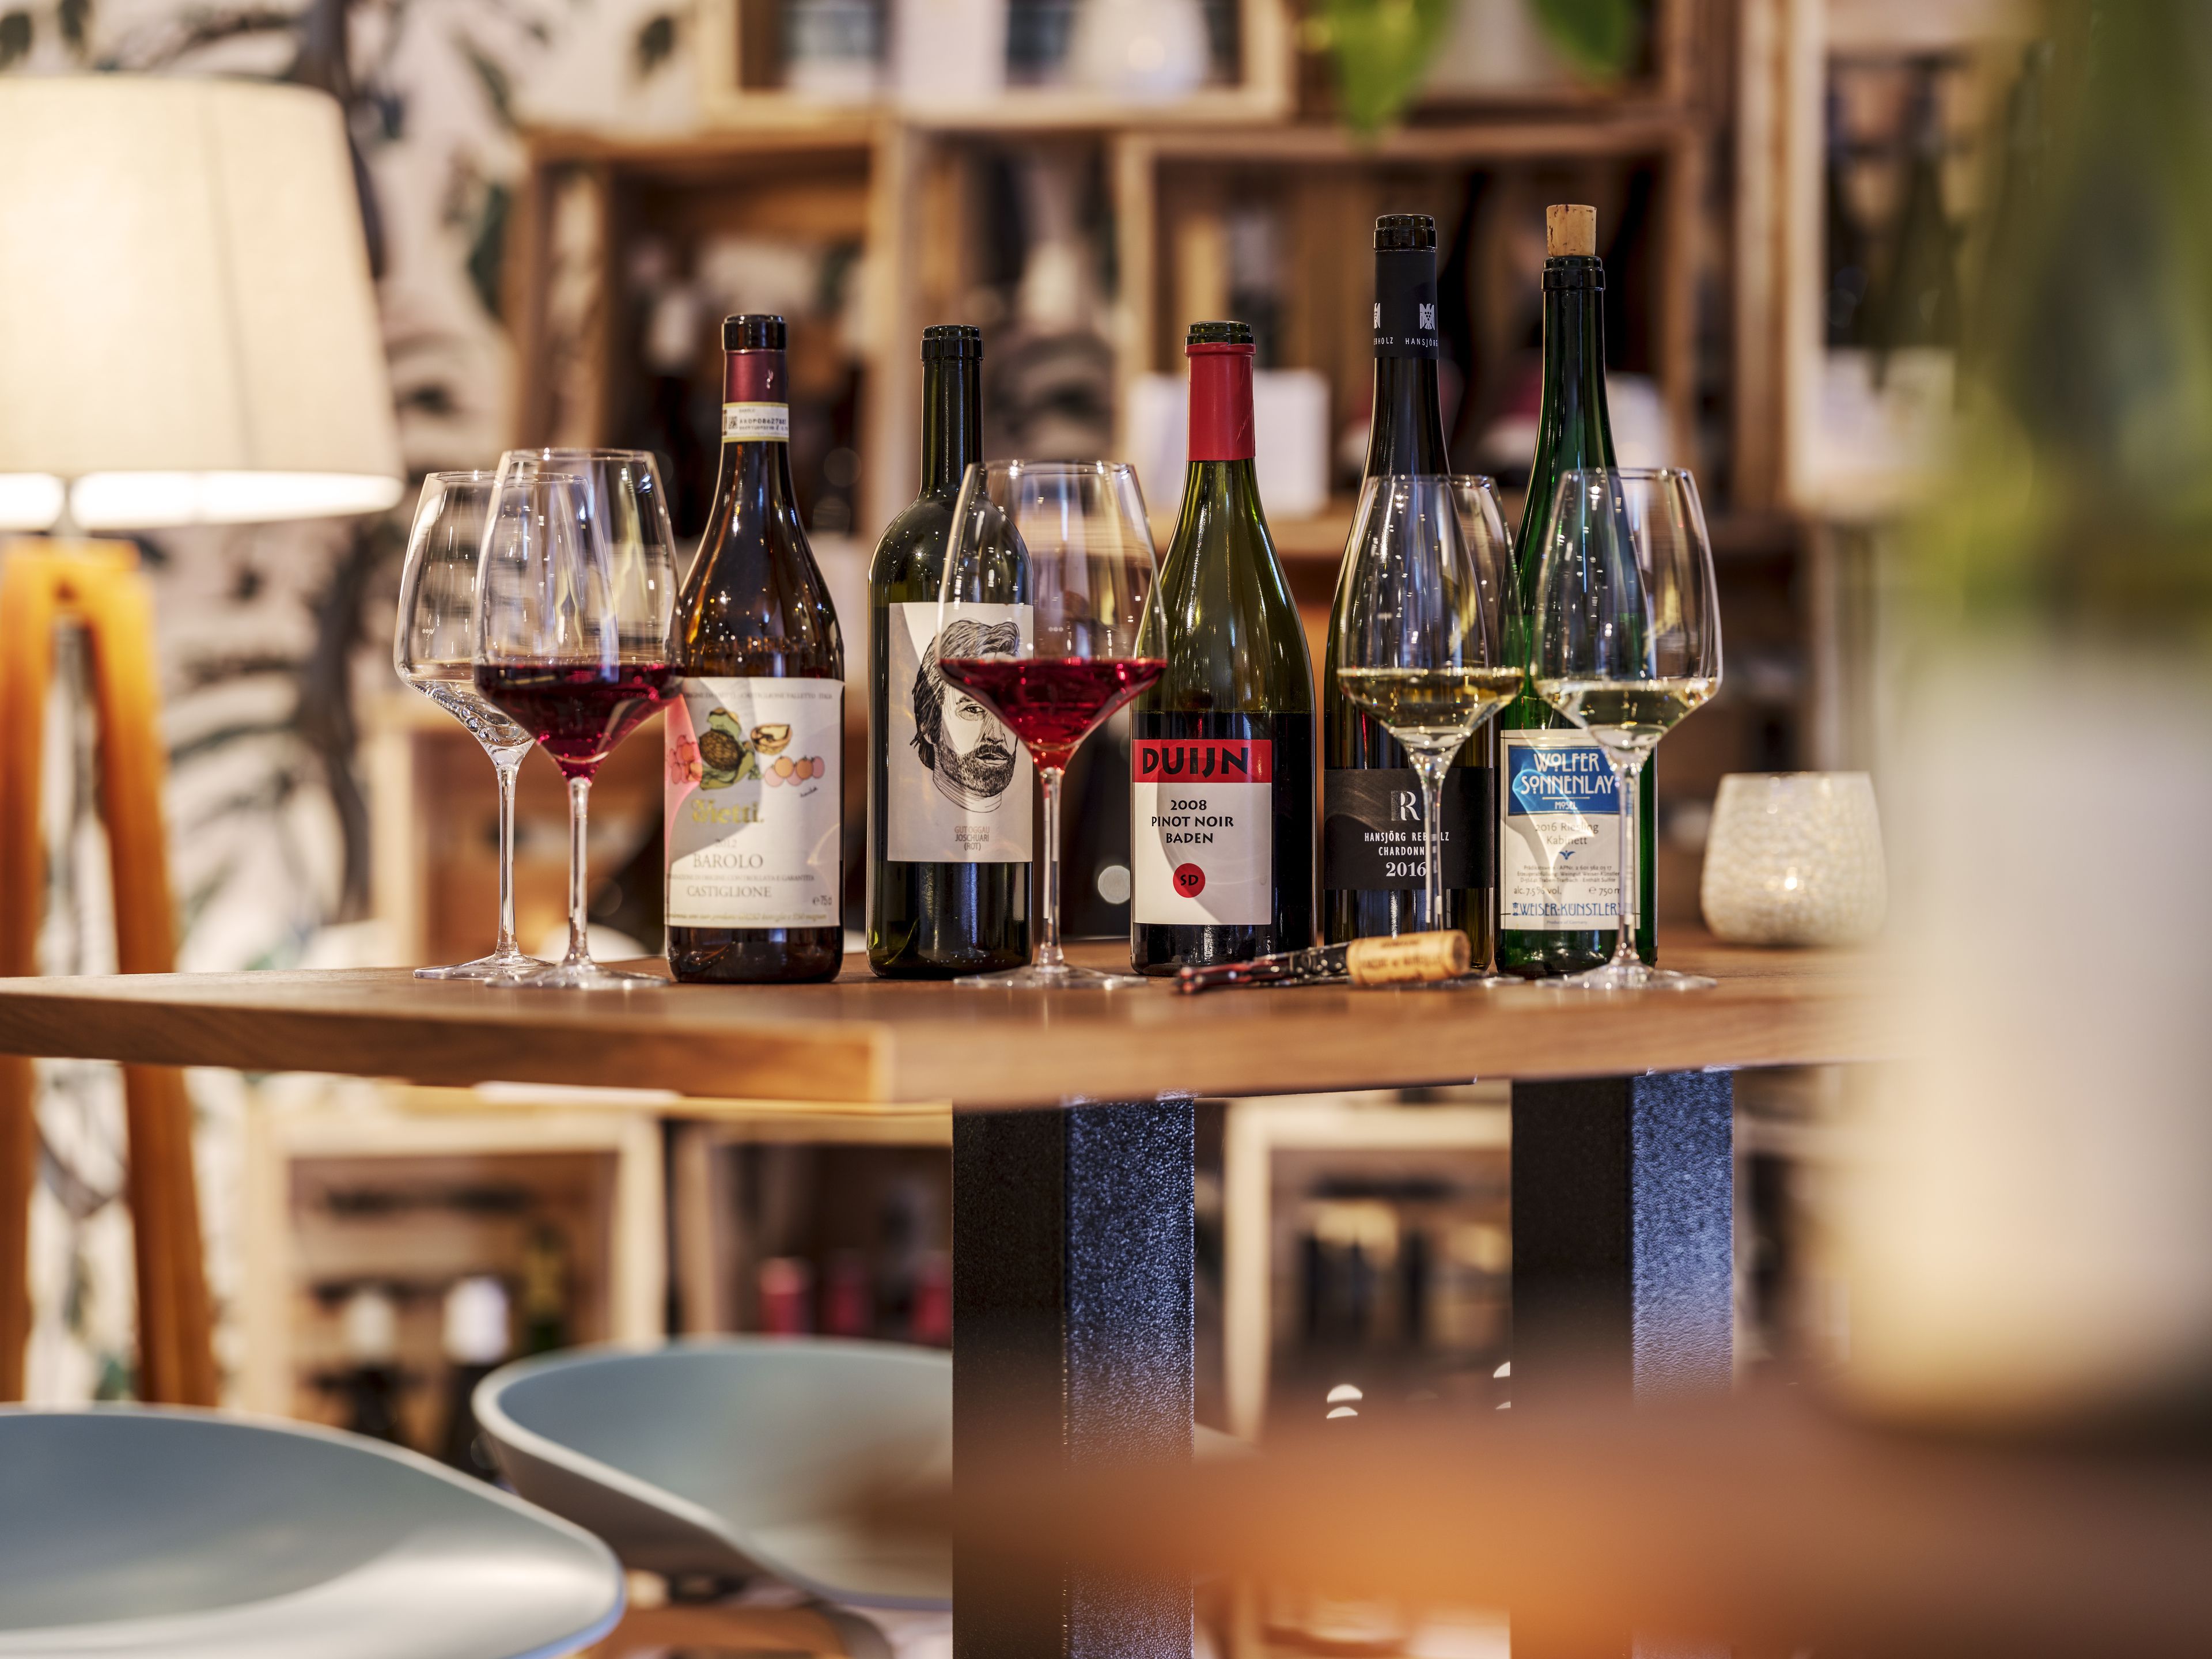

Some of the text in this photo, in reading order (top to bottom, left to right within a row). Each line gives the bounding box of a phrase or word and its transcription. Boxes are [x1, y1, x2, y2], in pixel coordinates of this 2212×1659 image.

[1406, 338, 1438, 347] HANSJÖRG
[1143, 747, 1248, 778] DUIJN
[1533, 753, 1600, 772] WOLFER
[1520, 775, 1614, 794] SONNENLAY
[1171, 800, 1207, 810] 2008
[1401, 791, 1421, 820] R
[1555, 801, 1577, 810] MOSEL
[1152, 816, 1234, 827] PINOT NOIR
[1535, 821, 1599, 834] 2016 Riesling
[955, 825, 967, 834] GUT
[1166, 833, 1213, 843] BADEN
[1365, 831, 1449, 843] HANSJÖRG REBLZ
[1547, 835, 1588, 844] Kabinett
[964, 842, 981, 851] (ROT)
[1378, 847, 1425, 855] CHARDONN
[693, 854, 763, 869] BAROLO
[1386, 862, 1427, 877] 2016
[1180, 874, 1199, 886] SD
[687, 885, 771, 897] CASTIGLIONE
[1514, 886, 1524, 894] alc.
[1548, 886, 1562, 894] vol.
[1520, 903, 1618, 916] WEISER-KÜNSTLER
